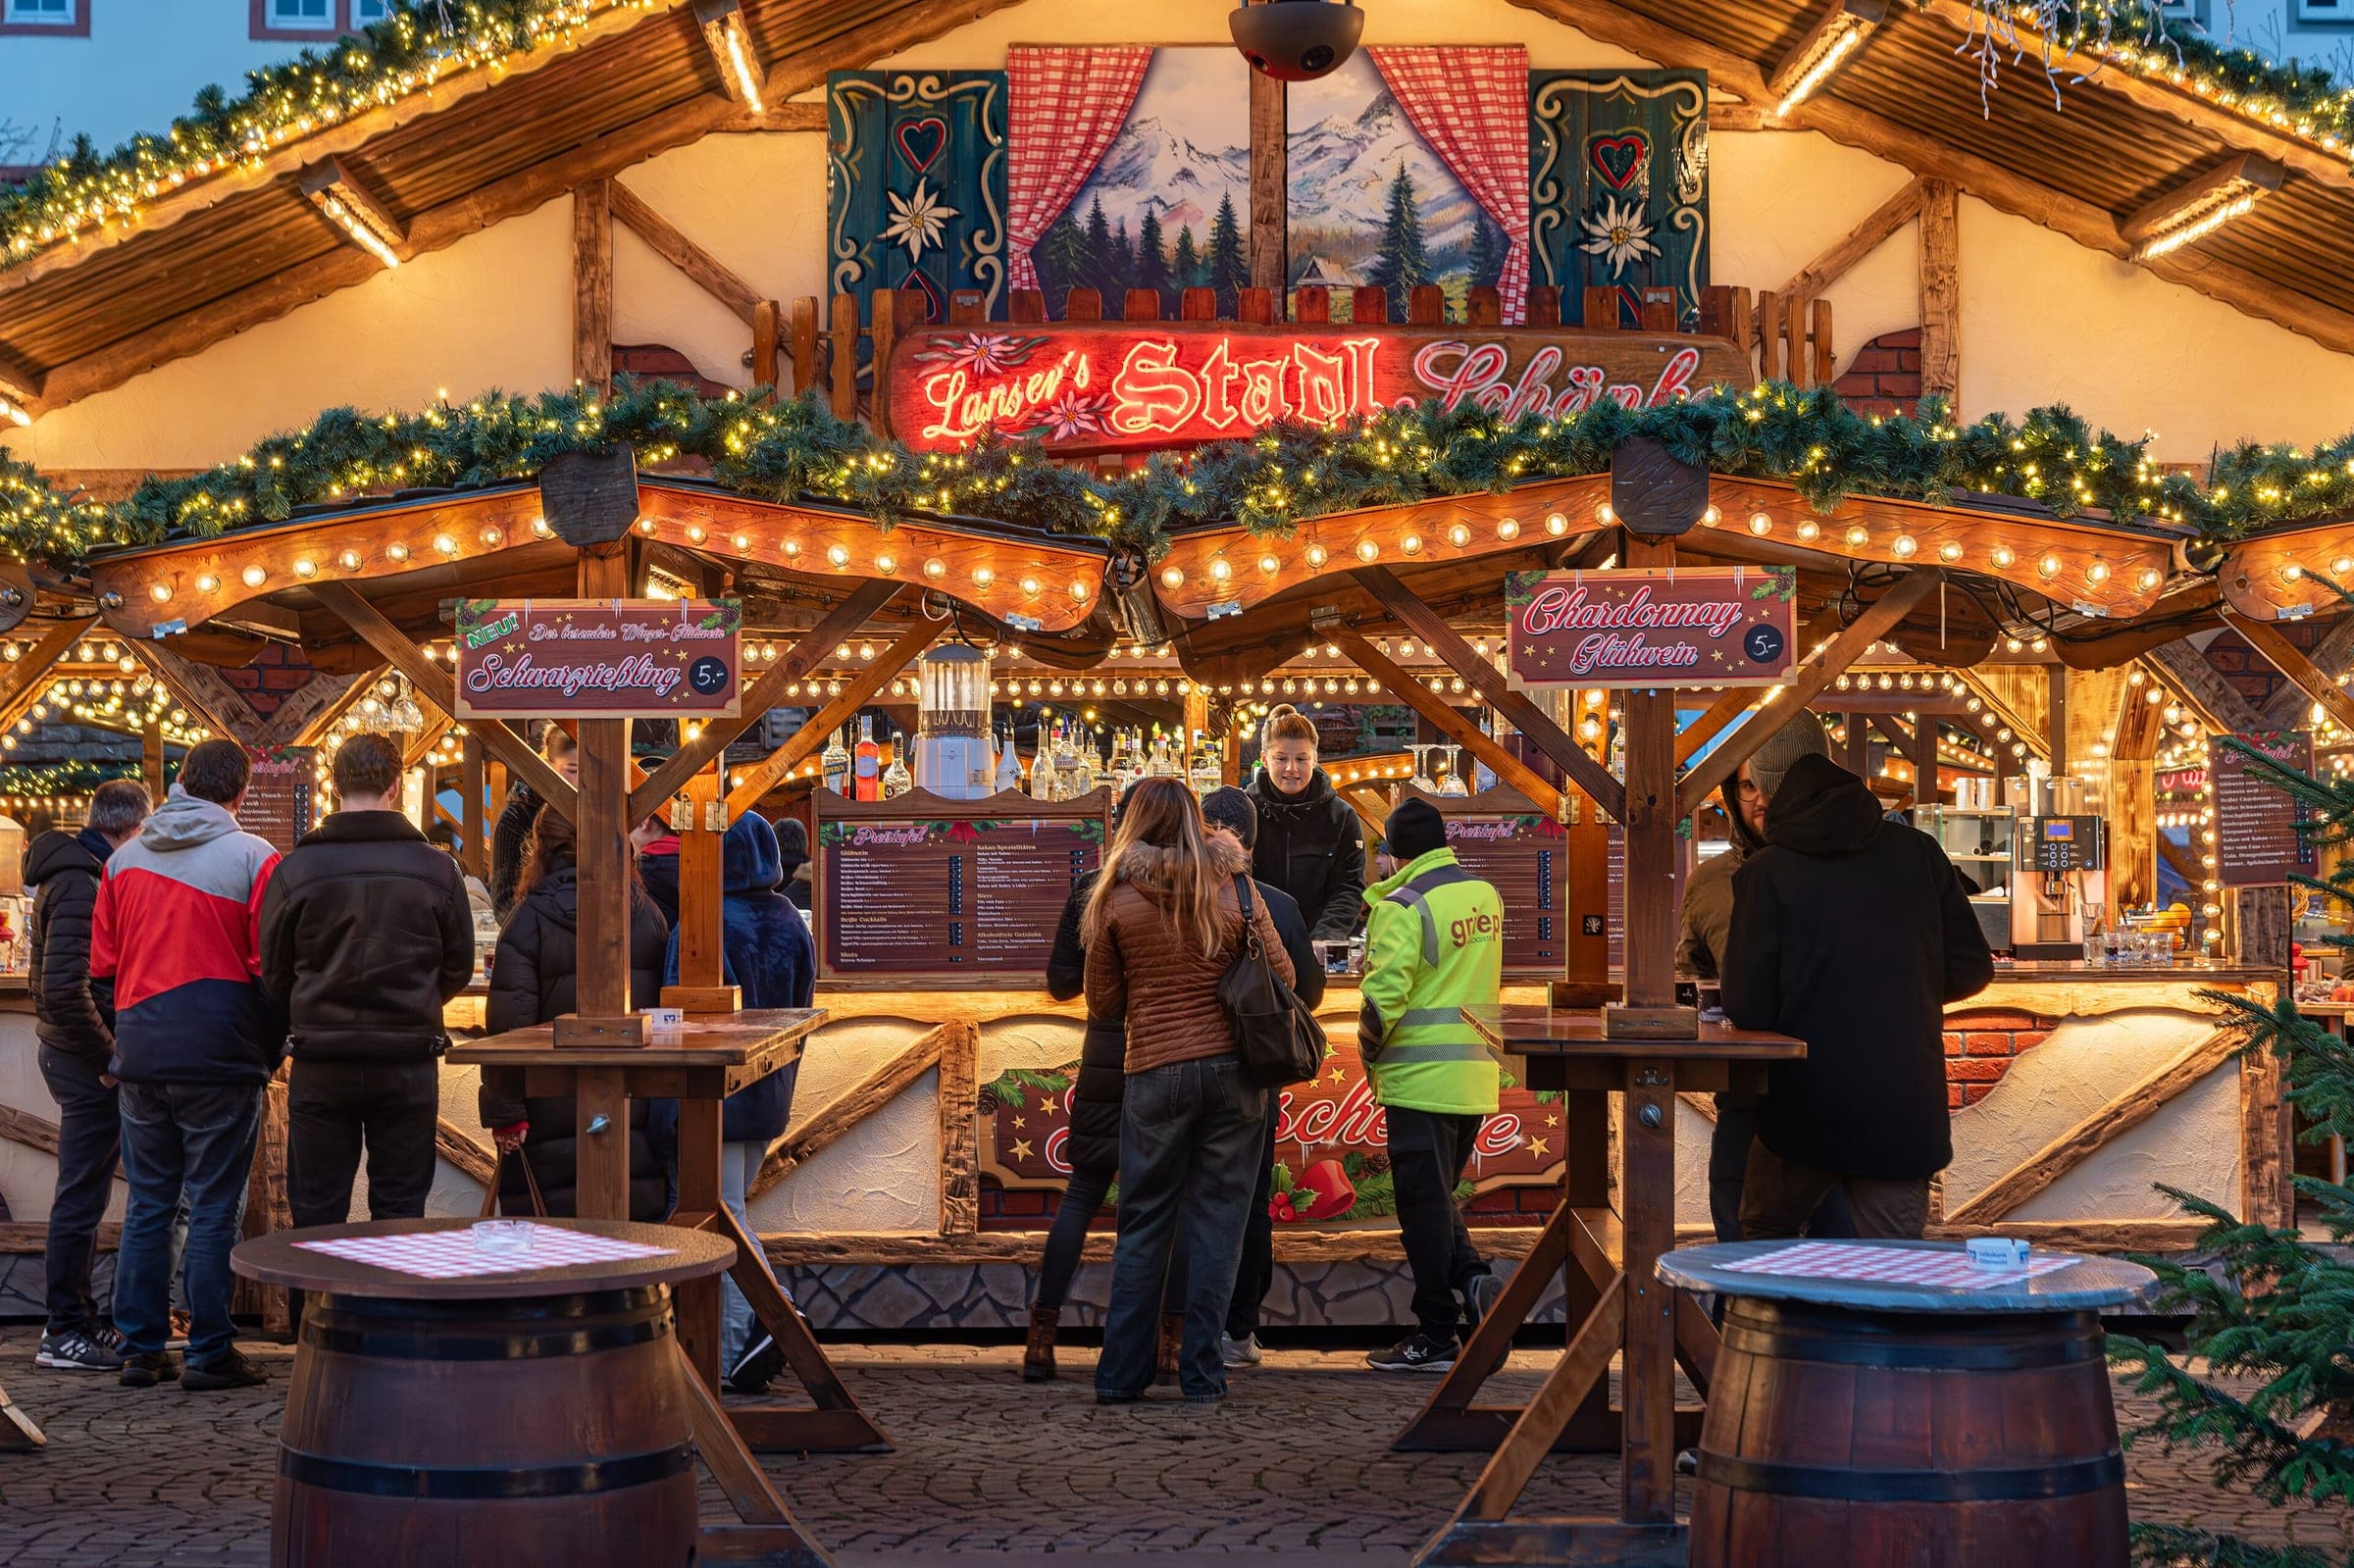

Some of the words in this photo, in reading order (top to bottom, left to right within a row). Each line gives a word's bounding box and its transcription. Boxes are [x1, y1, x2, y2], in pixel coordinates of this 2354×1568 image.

[922, 350, 1091, 439] Lanser's
[1111, 337, 1385, 434] Stadl
[466, 611, 520, 650] NEU!
[1523, 584, 1744, 637] Chardonnay
[560, 623, 617, 641] besondere
[467, 652, 682, 697] Schwarzrießling
[1569, 632, 1699, 675] Glühwein
[852, 825, 929, 848] Preistafel
[1451, 906, 1500, 948] griep
